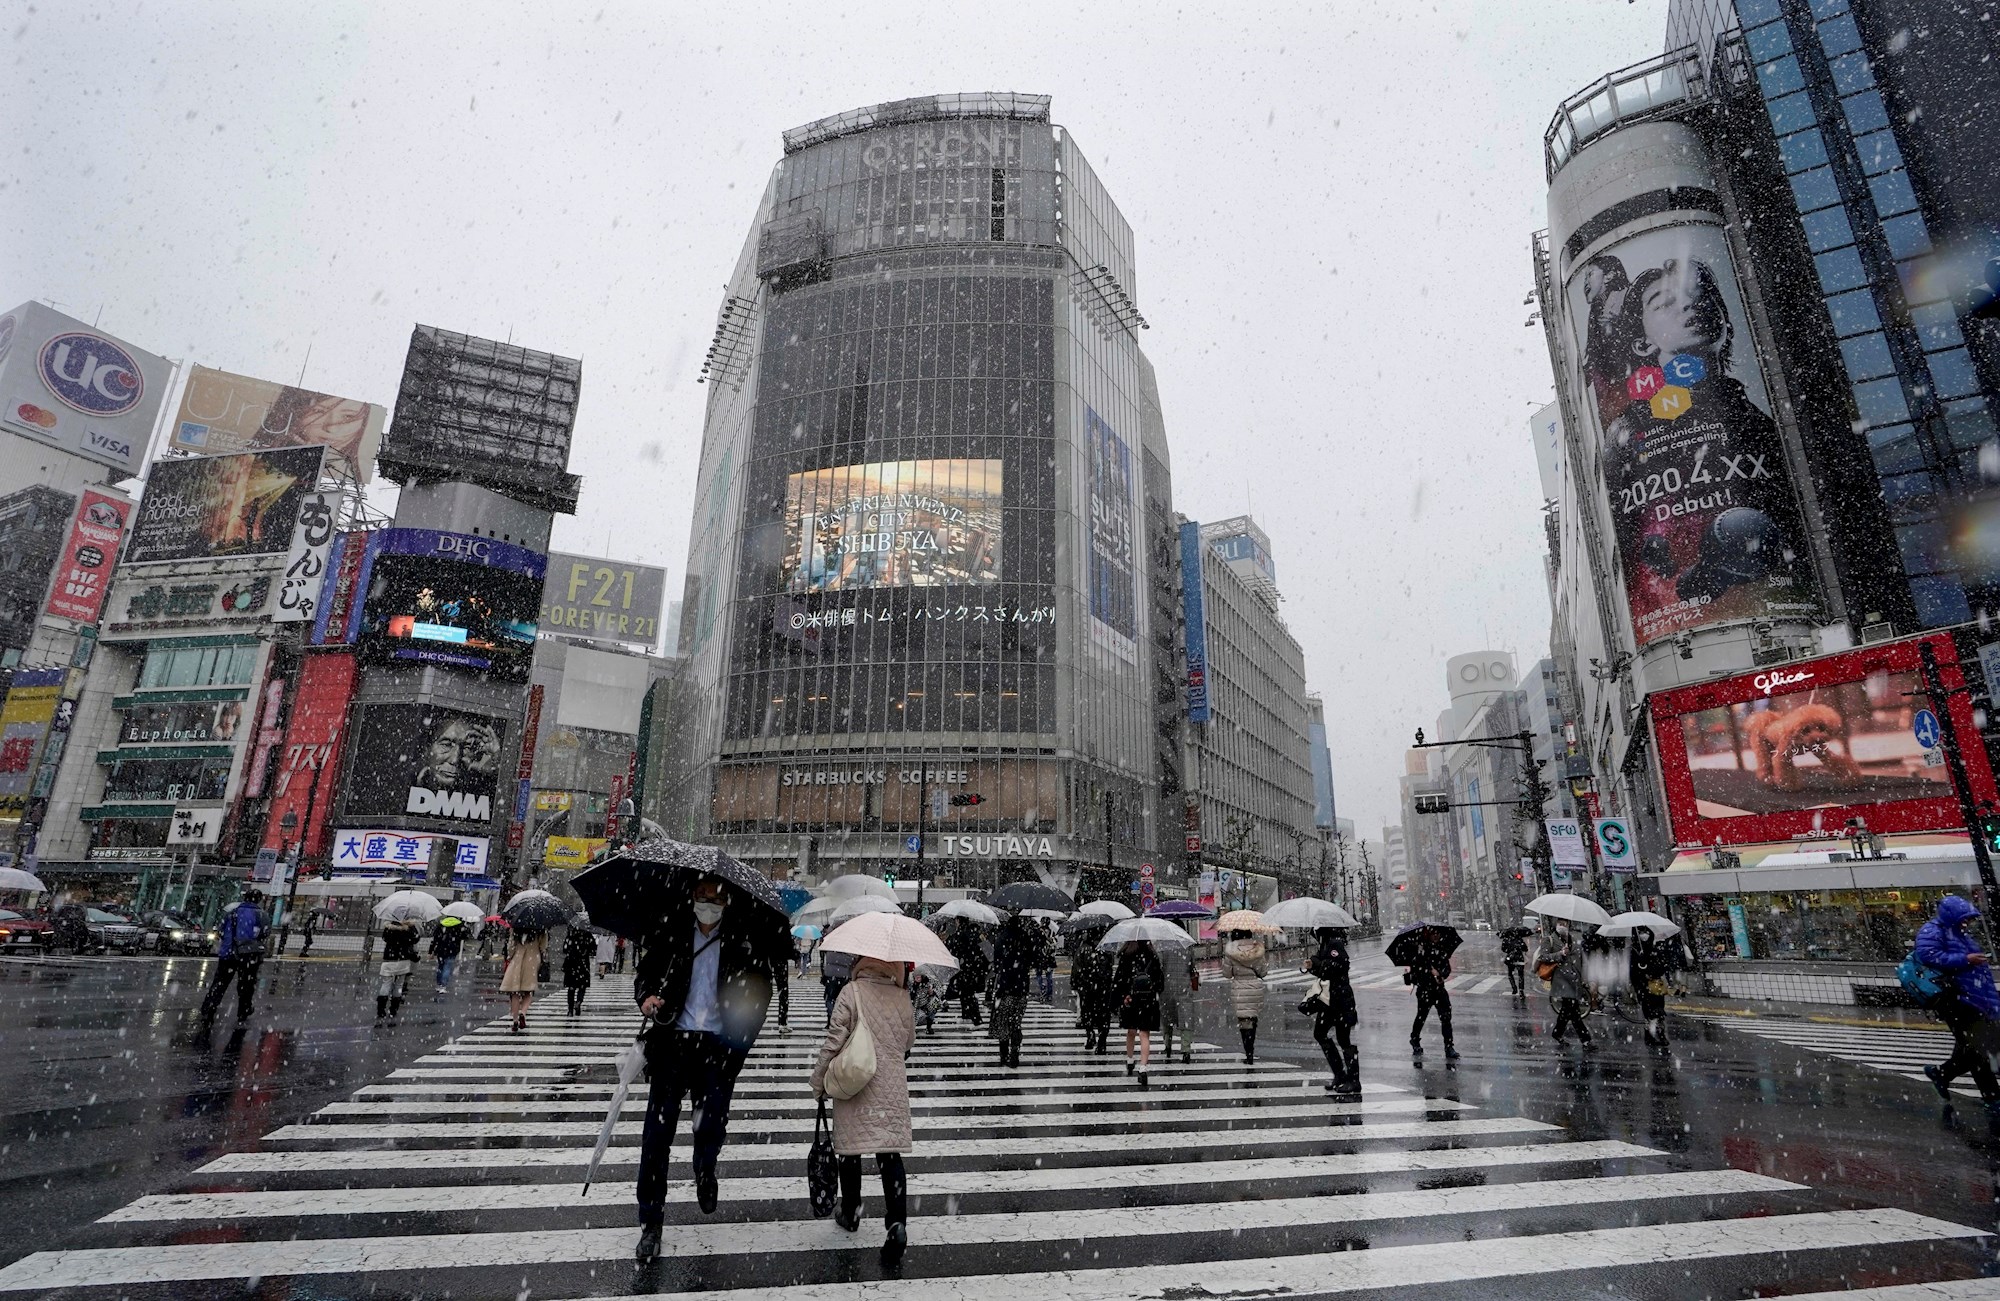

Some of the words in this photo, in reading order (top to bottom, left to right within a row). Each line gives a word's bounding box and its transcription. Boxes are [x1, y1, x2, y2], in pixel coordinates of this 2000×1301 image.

[1675, 362, 1692, 378] C
[1636, 373, 1655, 394] M
[1661, 394, 1680, 412] N
[89, 431, 130, 457] VISA
[1671, 431, 1728, 450] cancelling
[1619, 453, 1772, 514] 2020.4.XX
[145, 499, 204, 521] number
[149, 491, 184, 509] back
[818, 492, 963, 530] ENTERTAINMENT
[1655, 488, 1732, 522] Debut!
[868, 512, 907, 528] CITY
[437, 535, 490, 559] DHC
[838, 530, 938, 555] SHIBUYA
[279, 494, 333, 618] もんじゃ
[567, 563, 634, 610] F21
[1766, 602, 1819, 612] Panasonic
[541, 603, 629, 634] FOREVER
[633, 616, 655, 637] 21
[1642, 608, 1704, 637] 完全ワイヤレス
[419, 652, 437, 661] DHC
[438, 652, 469, 665] Channel
[1754, 671, 1815, 694] Glico
[129, 727, 206, 743] Euphoria
[782, 770, 888, 786] STARBUCKS
[899, 770, 968, 785] COFFEE
[406, 786, 490, 821] DMM
[340, 836, 479, 866] 大盛堂店
[943, 836, 1053, 856] TSUTAYA
